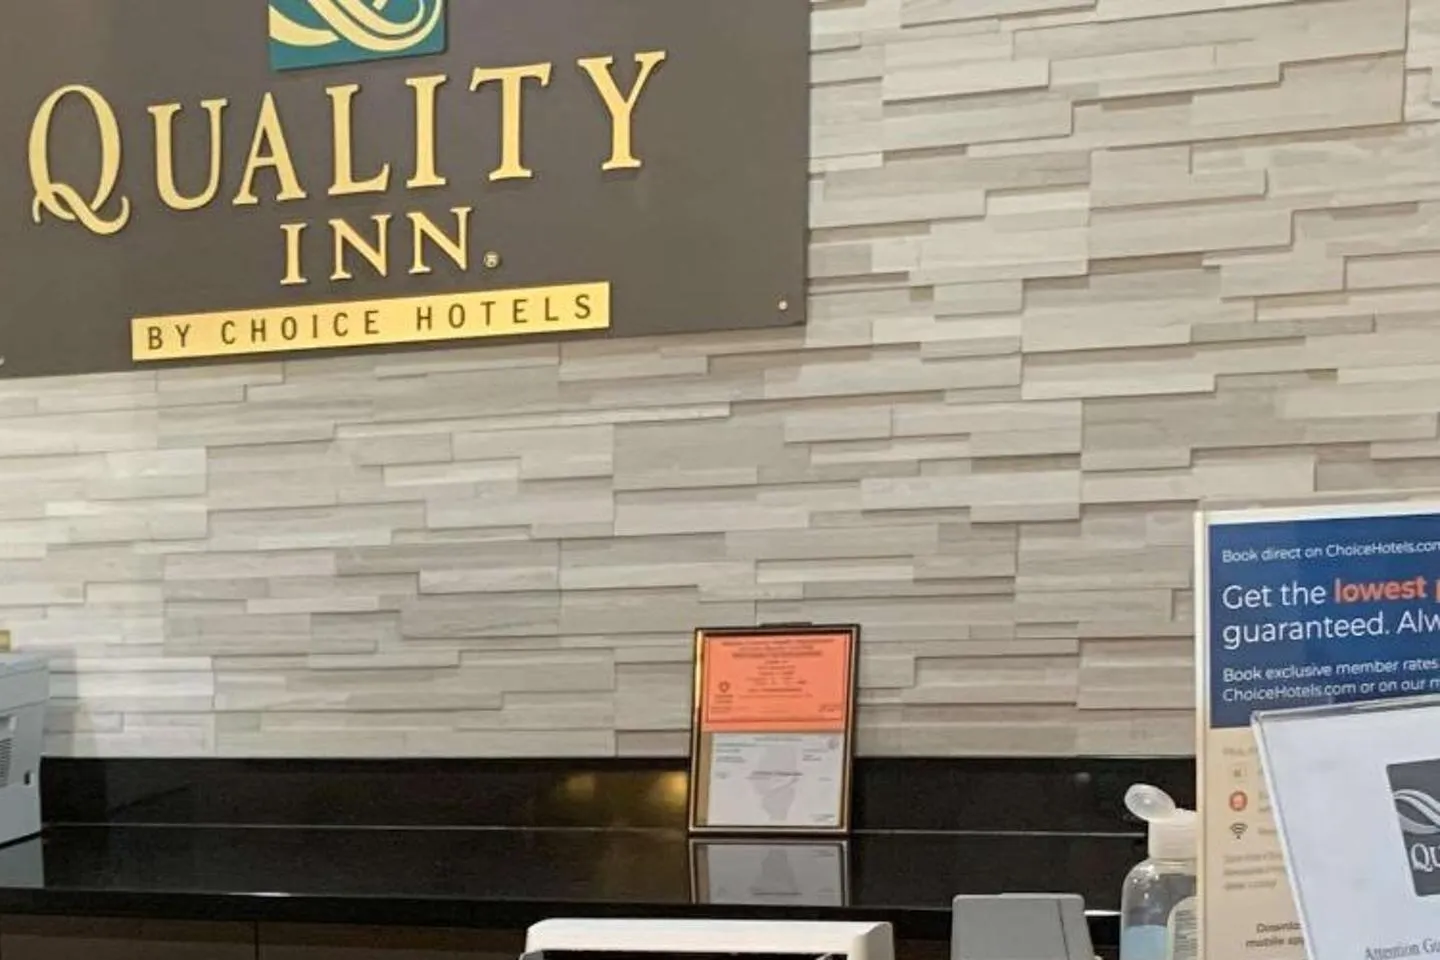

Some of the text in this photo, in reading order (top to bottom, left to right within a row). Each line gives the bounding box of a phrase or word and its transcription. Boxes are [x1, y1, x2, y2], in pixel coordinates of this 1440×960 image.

[28, 50, 667, 235] QUALITY
[147, 292, 594, 351] BY CHOICE HOTELS
[1222, 547, 1258, 563] Book
[1261, 547, 1301, 561] direct
[1304, 547, 1323, 559] on
[1222, 575, 1428, 609] Get the lowest
[1222, 610, 1390, 650] guaranteed.
[1222, 665, 1261, 682] Book
[1265, 664, 1333, 680] exclusive
[1336, 660, 1399, 675] member
[1222, 682, 1357, 702] ChoiceHotels.com
[1360, 682, 1375, 694] or
[1379, 680, 1398, 692] on
[1401, 679, 1426, 690] our
